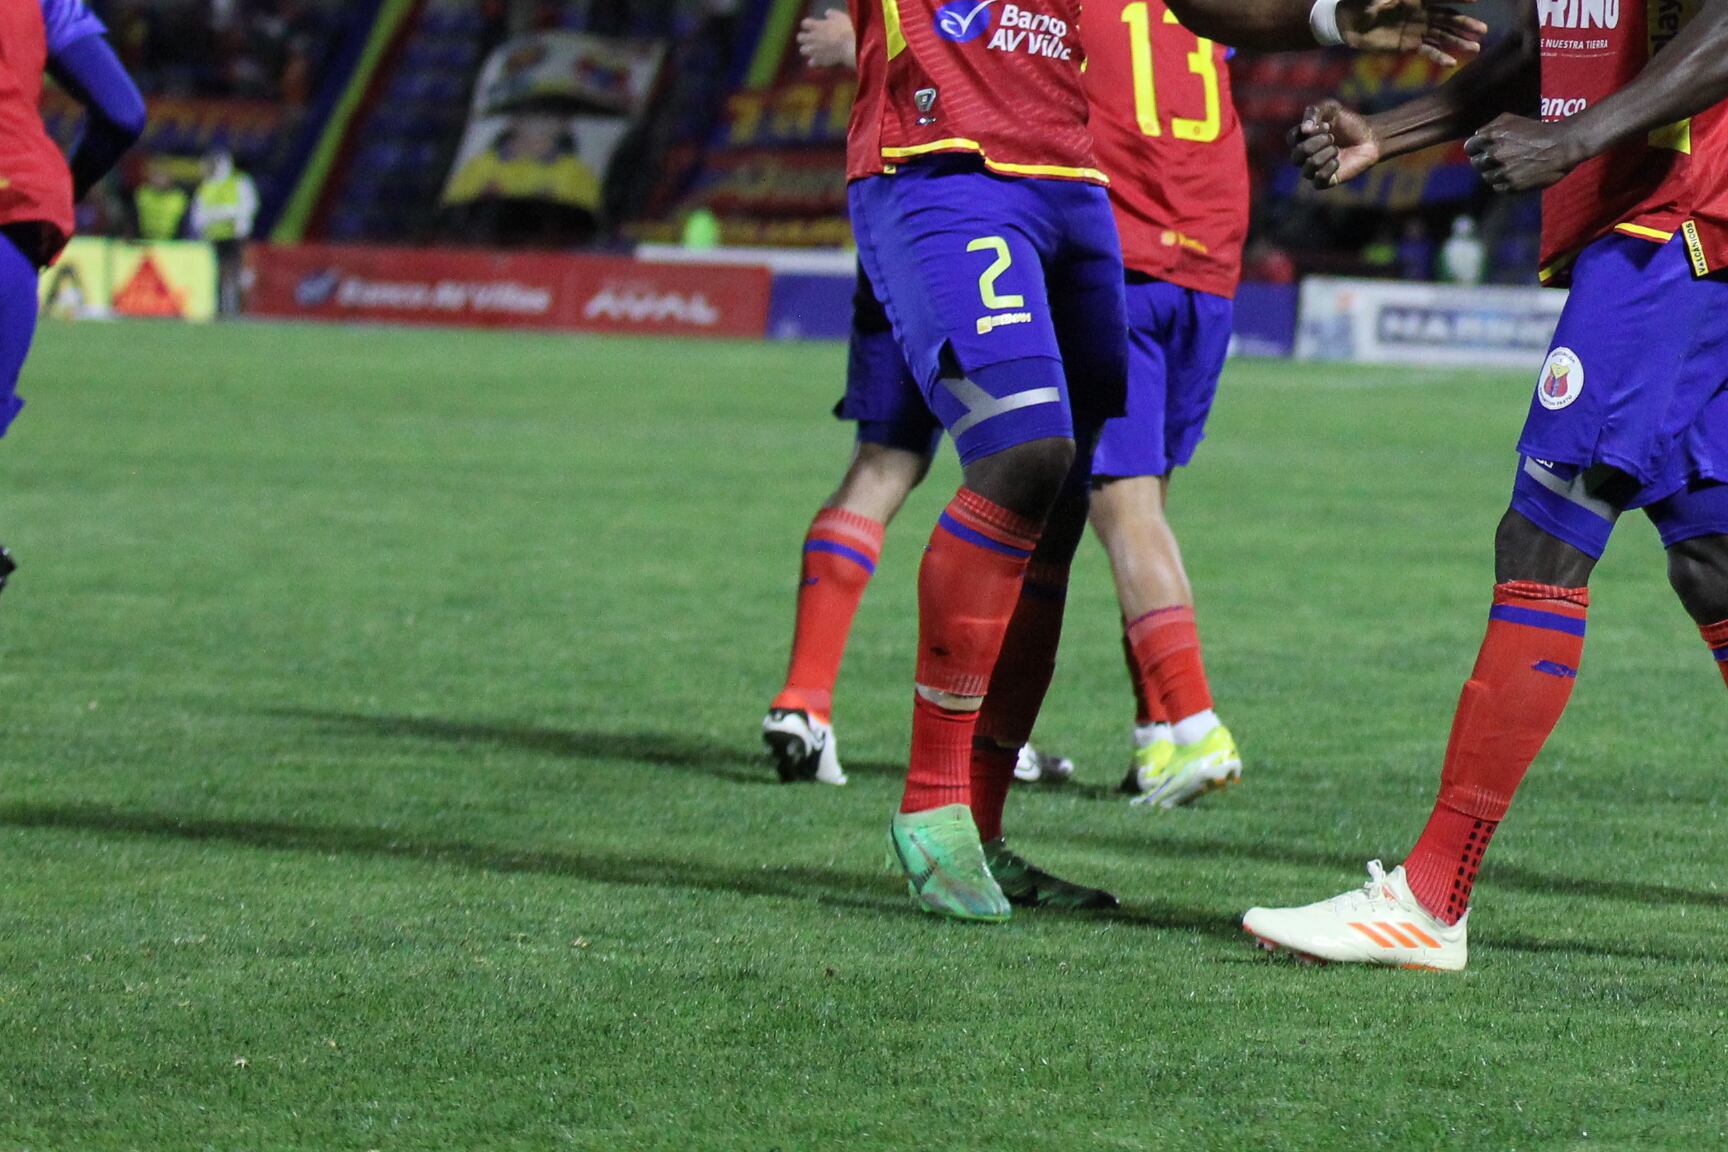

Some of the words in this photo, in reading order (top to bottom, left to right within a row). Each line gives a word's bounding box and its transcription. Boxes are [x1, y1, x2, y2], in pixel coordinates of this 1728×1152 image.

[999, 3, 1067, 38] Banco
[986, 27, 1027, 52] AV
[1545, 37, 1584, 50] NUESTRA
[1586, 39, 1609, 49] TIERRA
[1120, 0, 1222, 143] 13
[1540, 96, 1587, 118] anco
[966, 235, 1025, 311] 2
